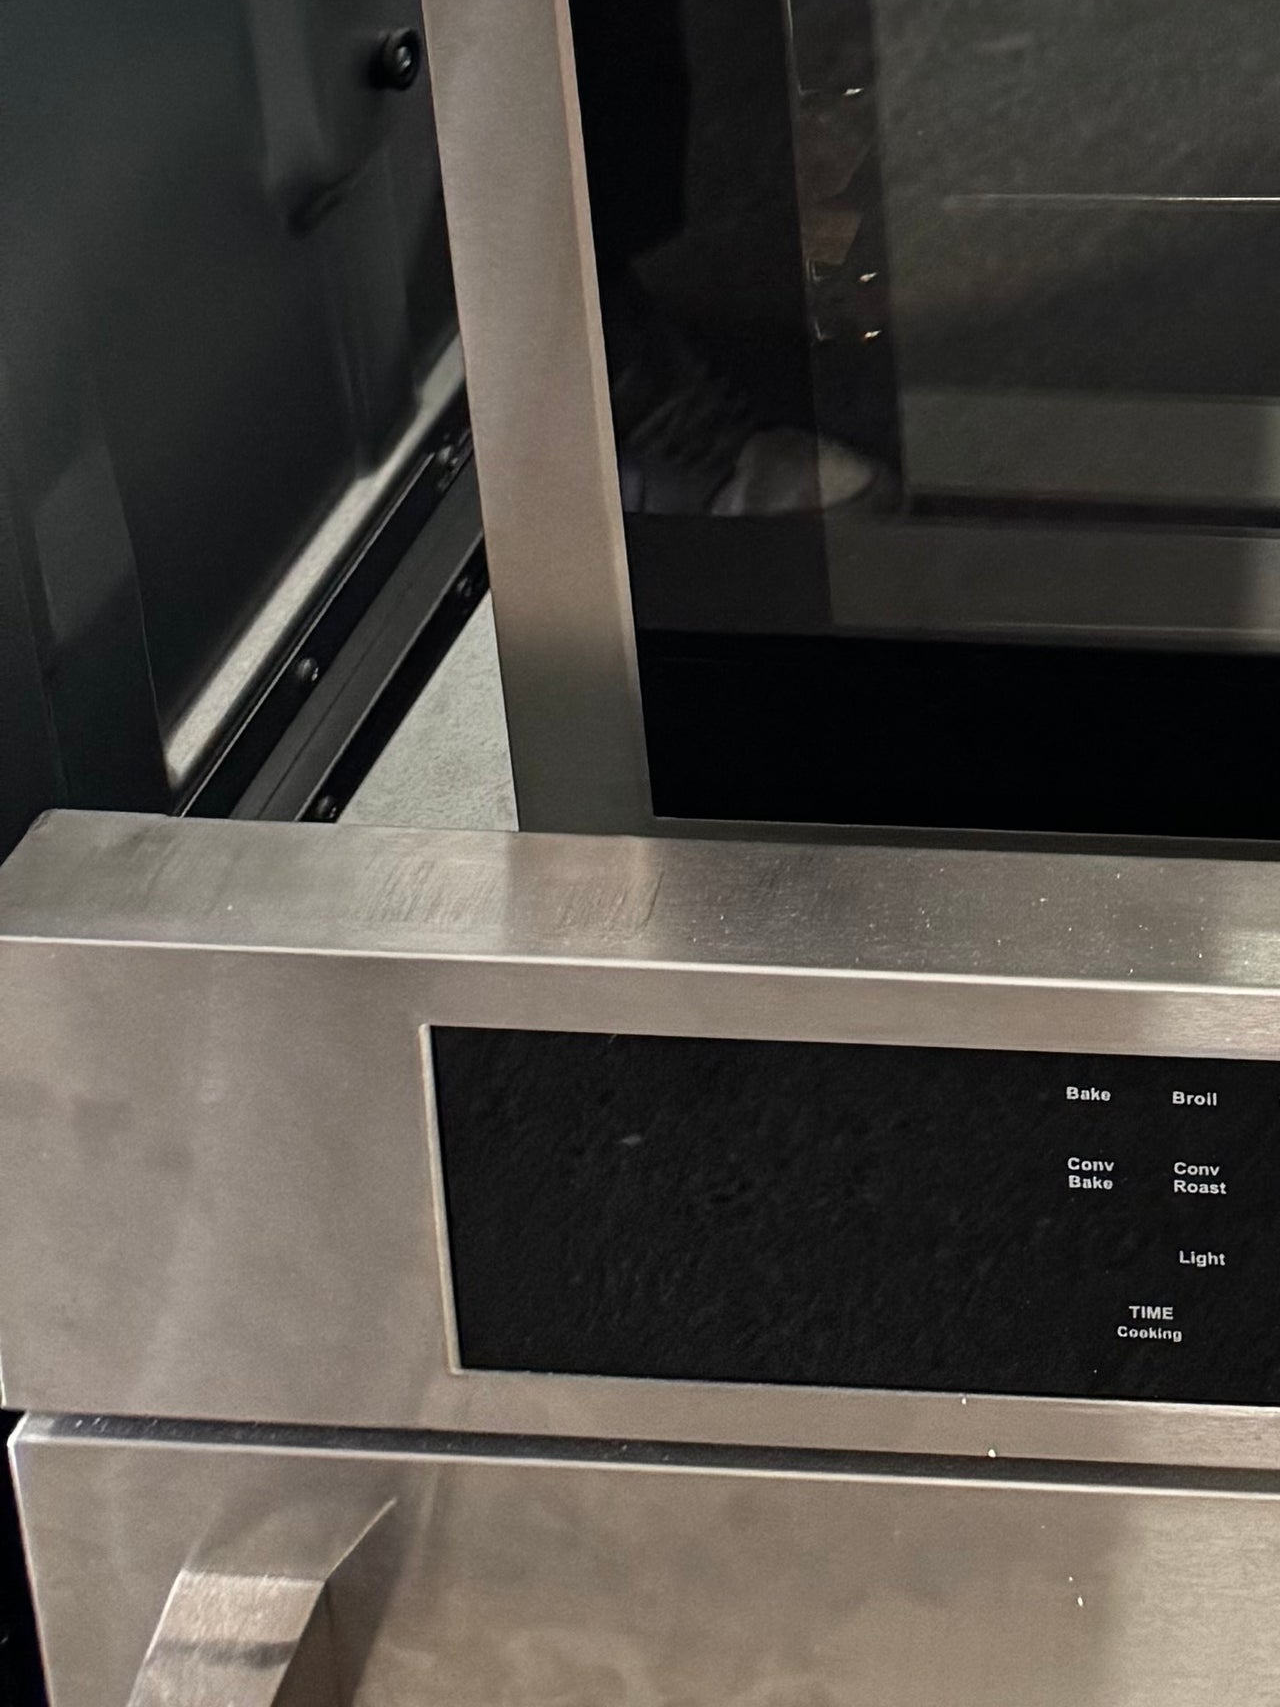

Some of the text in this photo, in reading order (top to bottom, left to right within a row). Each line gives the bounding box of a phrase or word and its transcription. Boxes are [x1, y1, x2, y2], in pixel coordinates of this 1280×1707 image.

[1066, 1086, 1111, 1102] Bake
[1172, 1090, 1217, 1106] Broil
[1067, 1157, 1115, 1172] Conv
[1173, 1161, 1220, 1177] Conv
[1068, 1174, 1114, 1190] Bake
[1173, 1179, 1227, 1195] Roast
[1179, 1250, 1226, 1268] Light
[1128, 1305, 1174, 1320] TIME
[1117, 1325, 1183, 1343] Cooking
